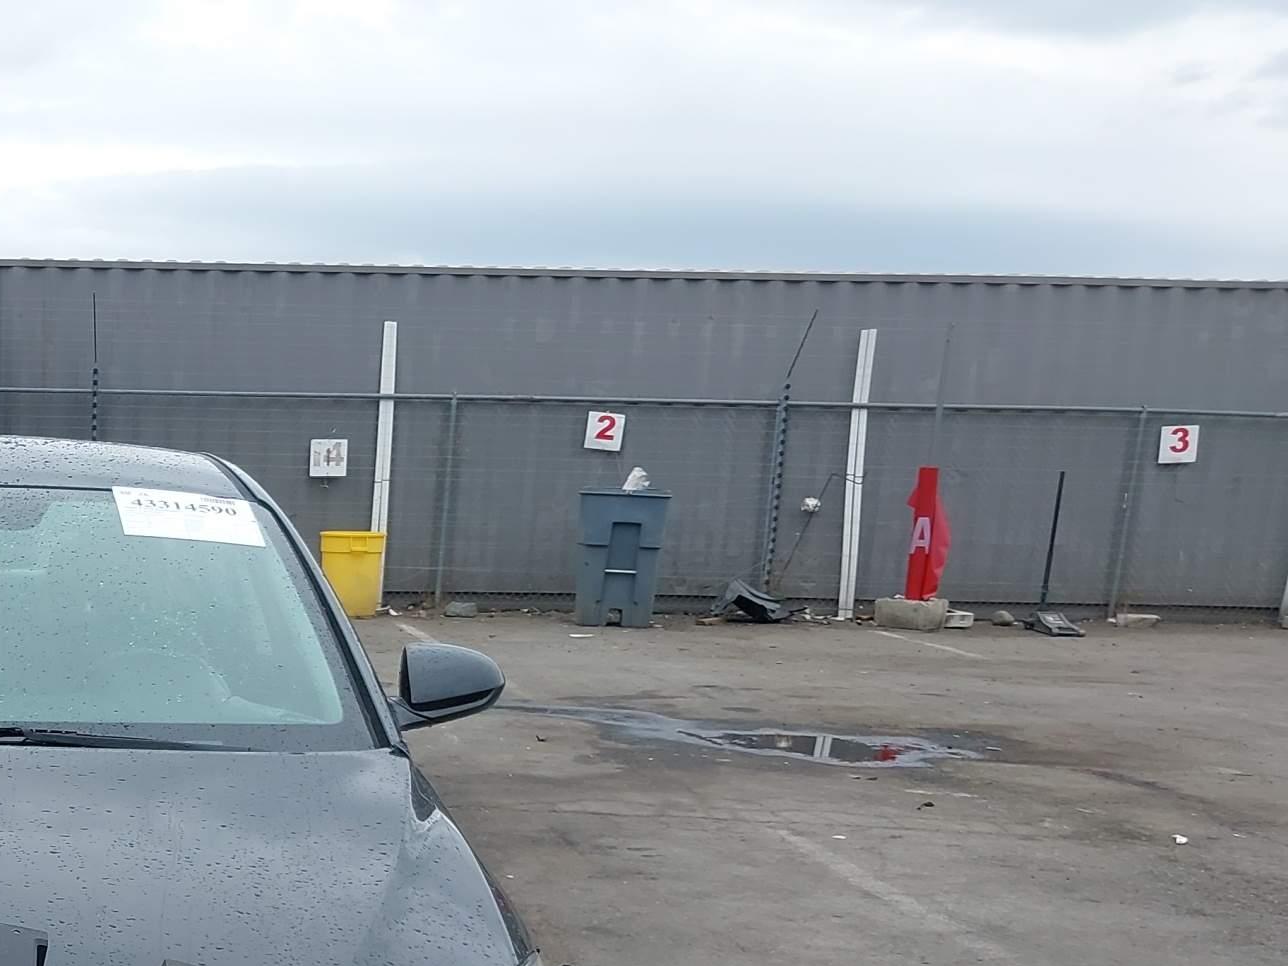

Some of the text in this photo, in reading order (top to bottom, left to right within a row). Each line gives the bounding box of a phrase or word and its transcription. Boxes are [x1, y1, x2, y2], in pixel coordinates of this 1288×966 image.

[595, 415, 616, 441] 2
[1169, 427, 1189, 453] 3
[131, 498, 237, 516] 43314590
